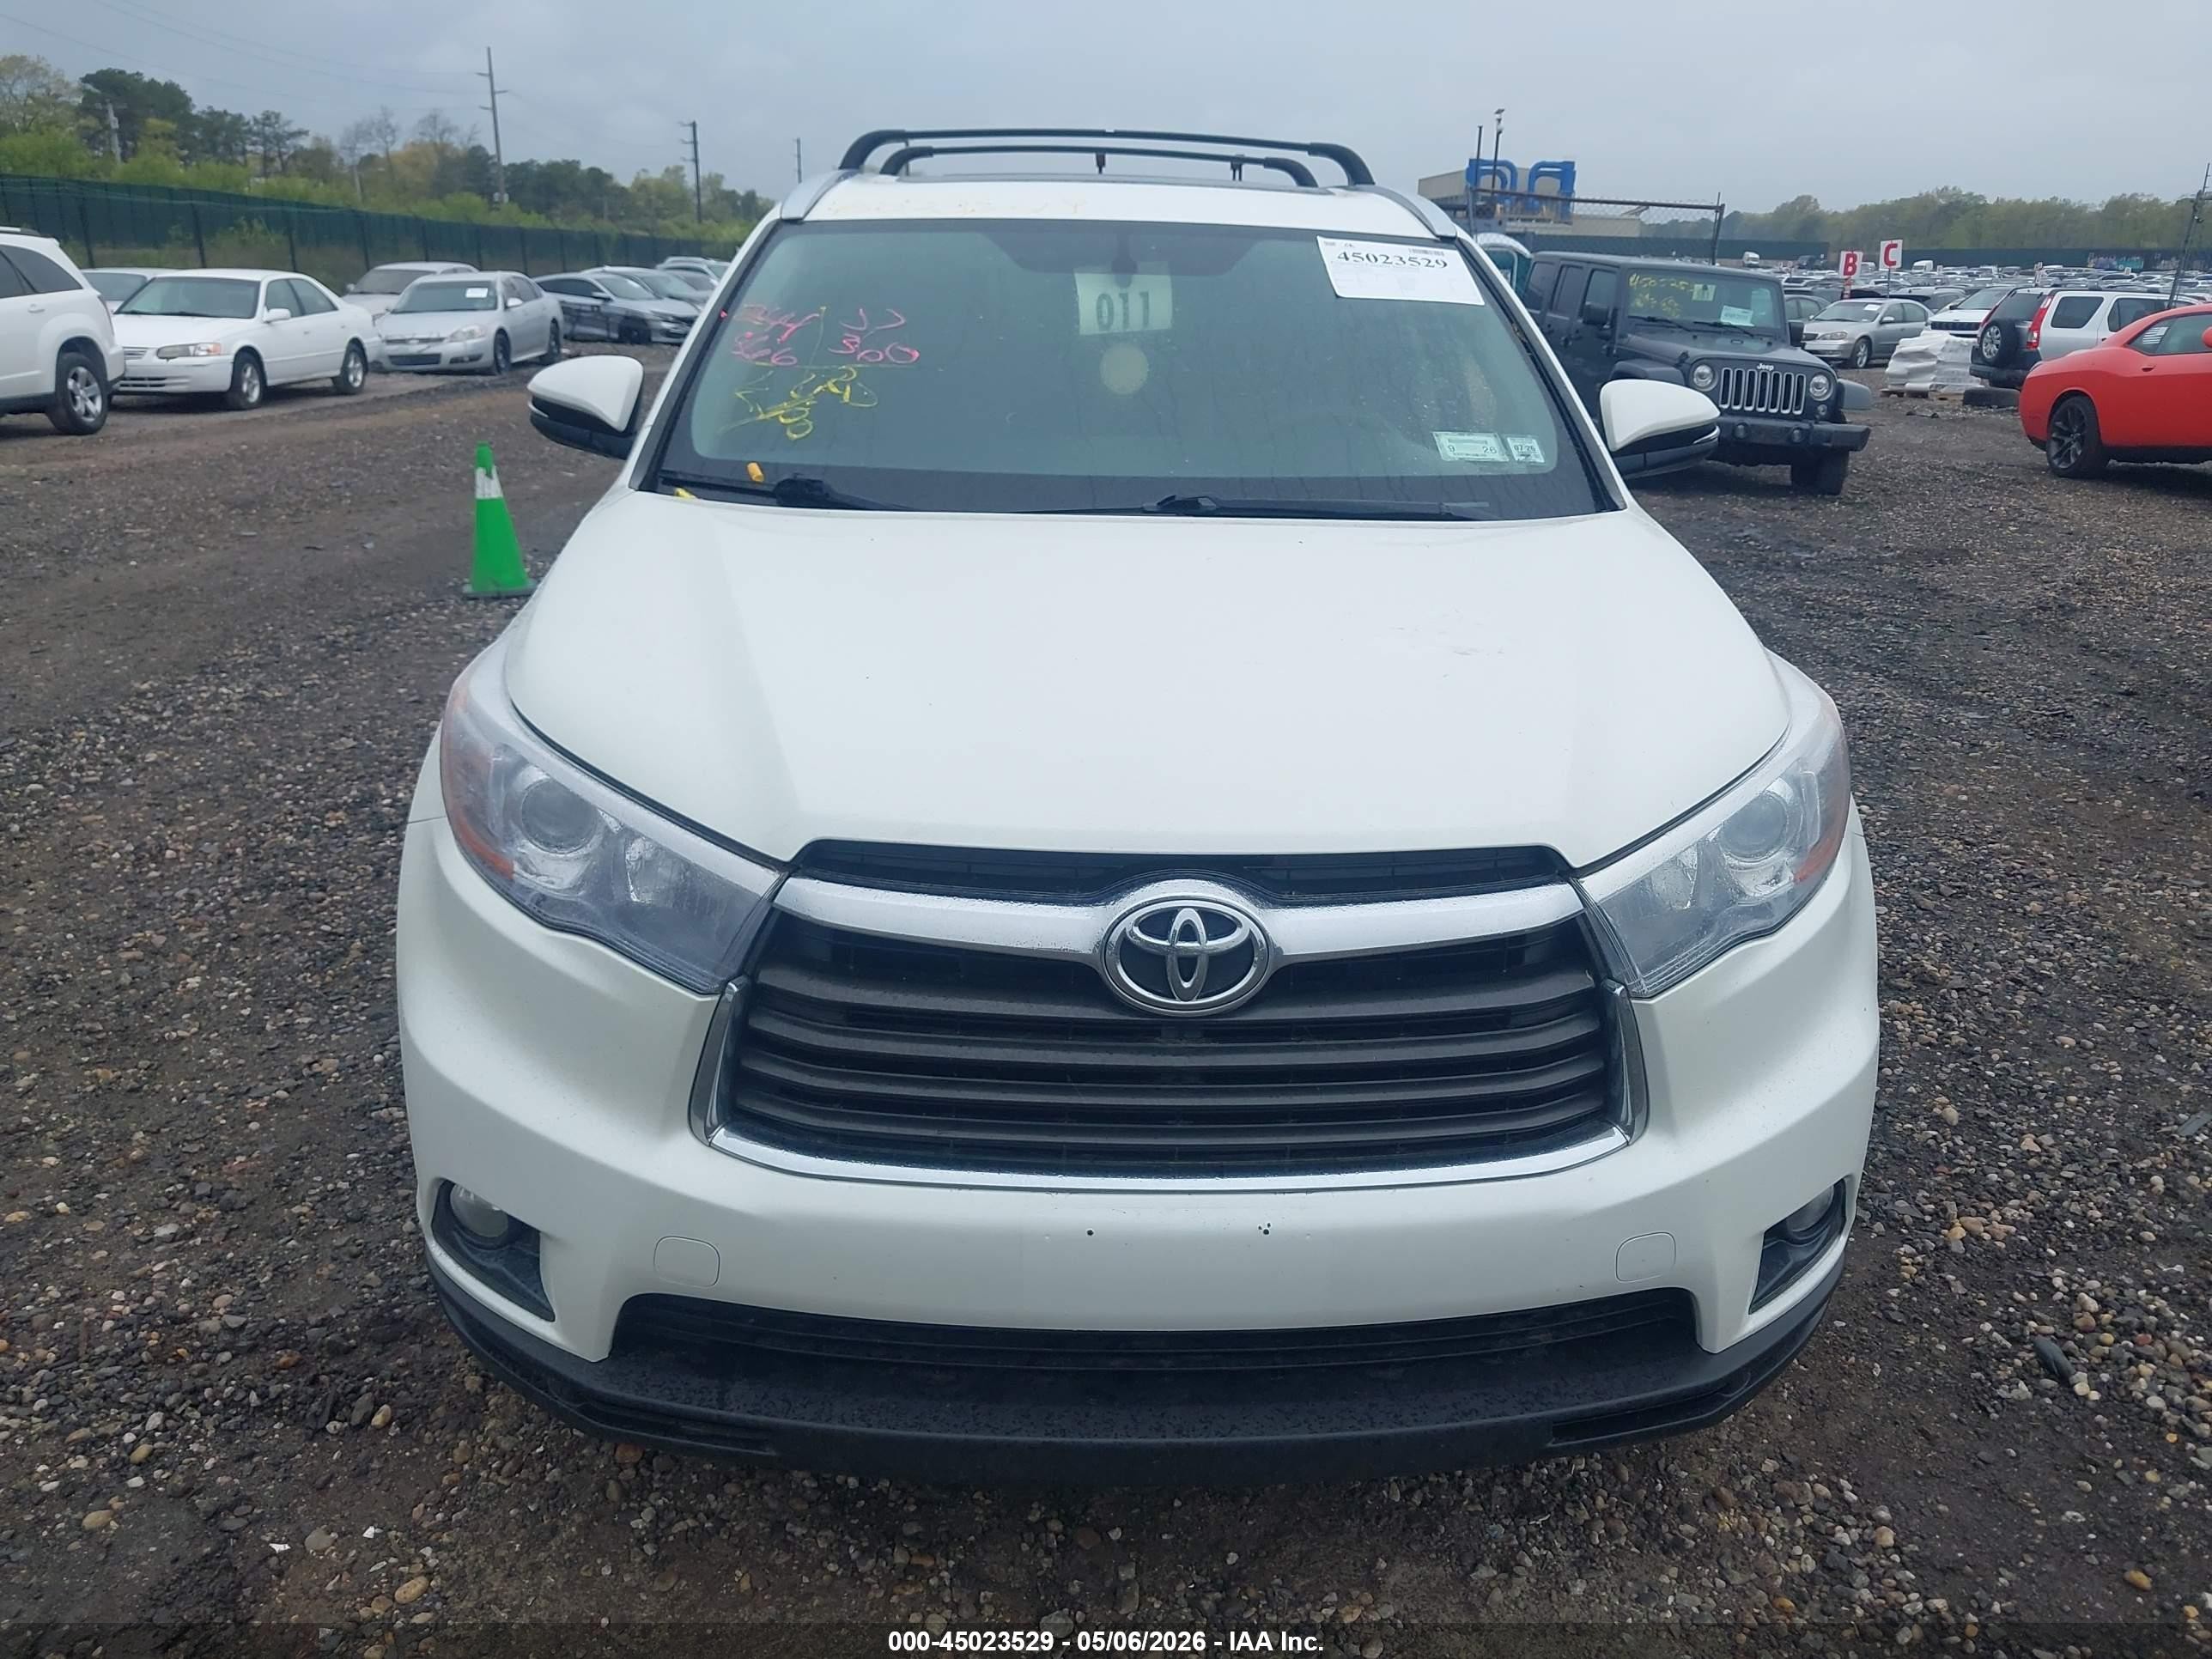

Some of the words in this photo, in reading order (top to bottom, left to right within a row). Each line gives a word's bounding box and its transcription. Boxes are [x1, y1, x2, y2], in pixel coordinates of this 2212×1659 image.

[1337, 250, 1449, 270] 45023529
[1843, 252, 1858, 276] B
[1883, 243, 1899, 267] C
[1096, 291, 1150, 331] 011
[1756, 362, 1775, 373] Jeep
